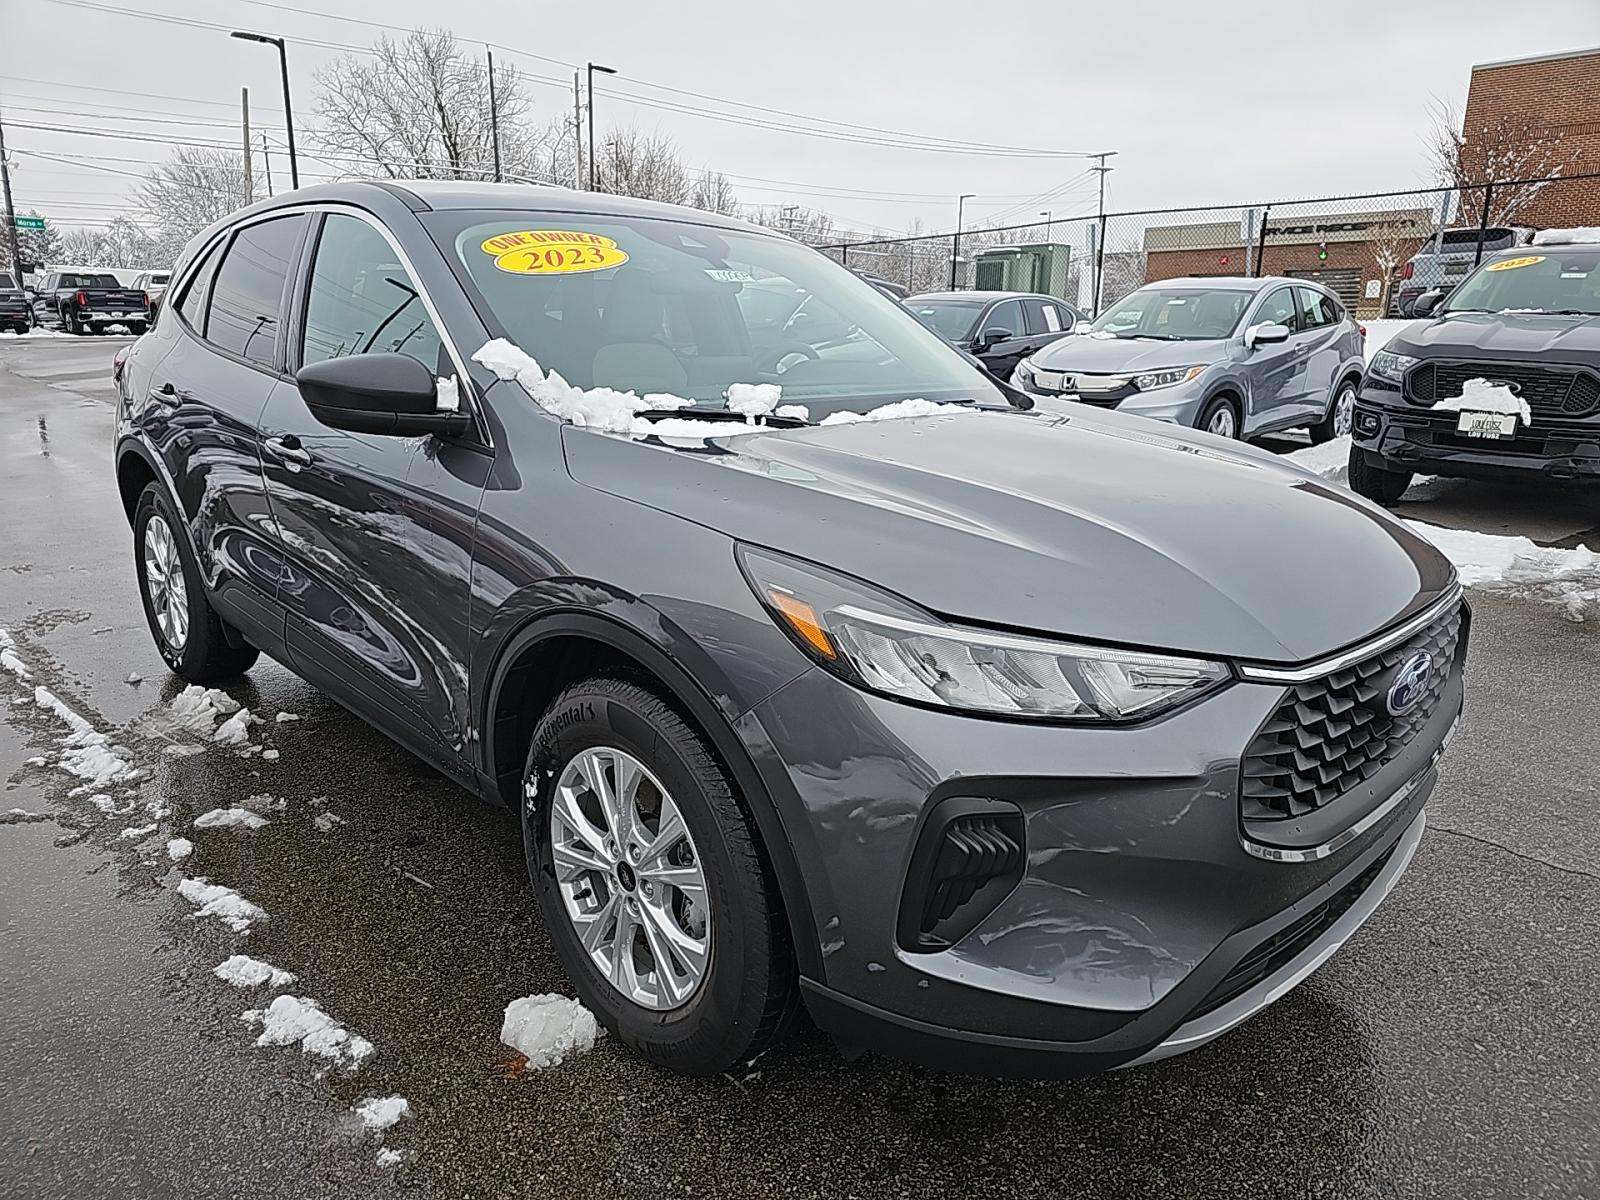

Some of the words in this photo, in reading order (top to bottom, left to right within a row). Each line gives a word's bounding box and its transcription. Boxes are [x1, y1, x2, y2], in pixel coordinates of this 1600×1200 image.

[1265, 225, 1314, 236] RVICE
[1316, 219, 1415, 233] RECEP
[489, 233, 530, 250] ONE
[530, 232, 603, 245] OWNER
[522, 247, 606, 270] 2023
[1486, 420, 1502, 429] FUSZ
